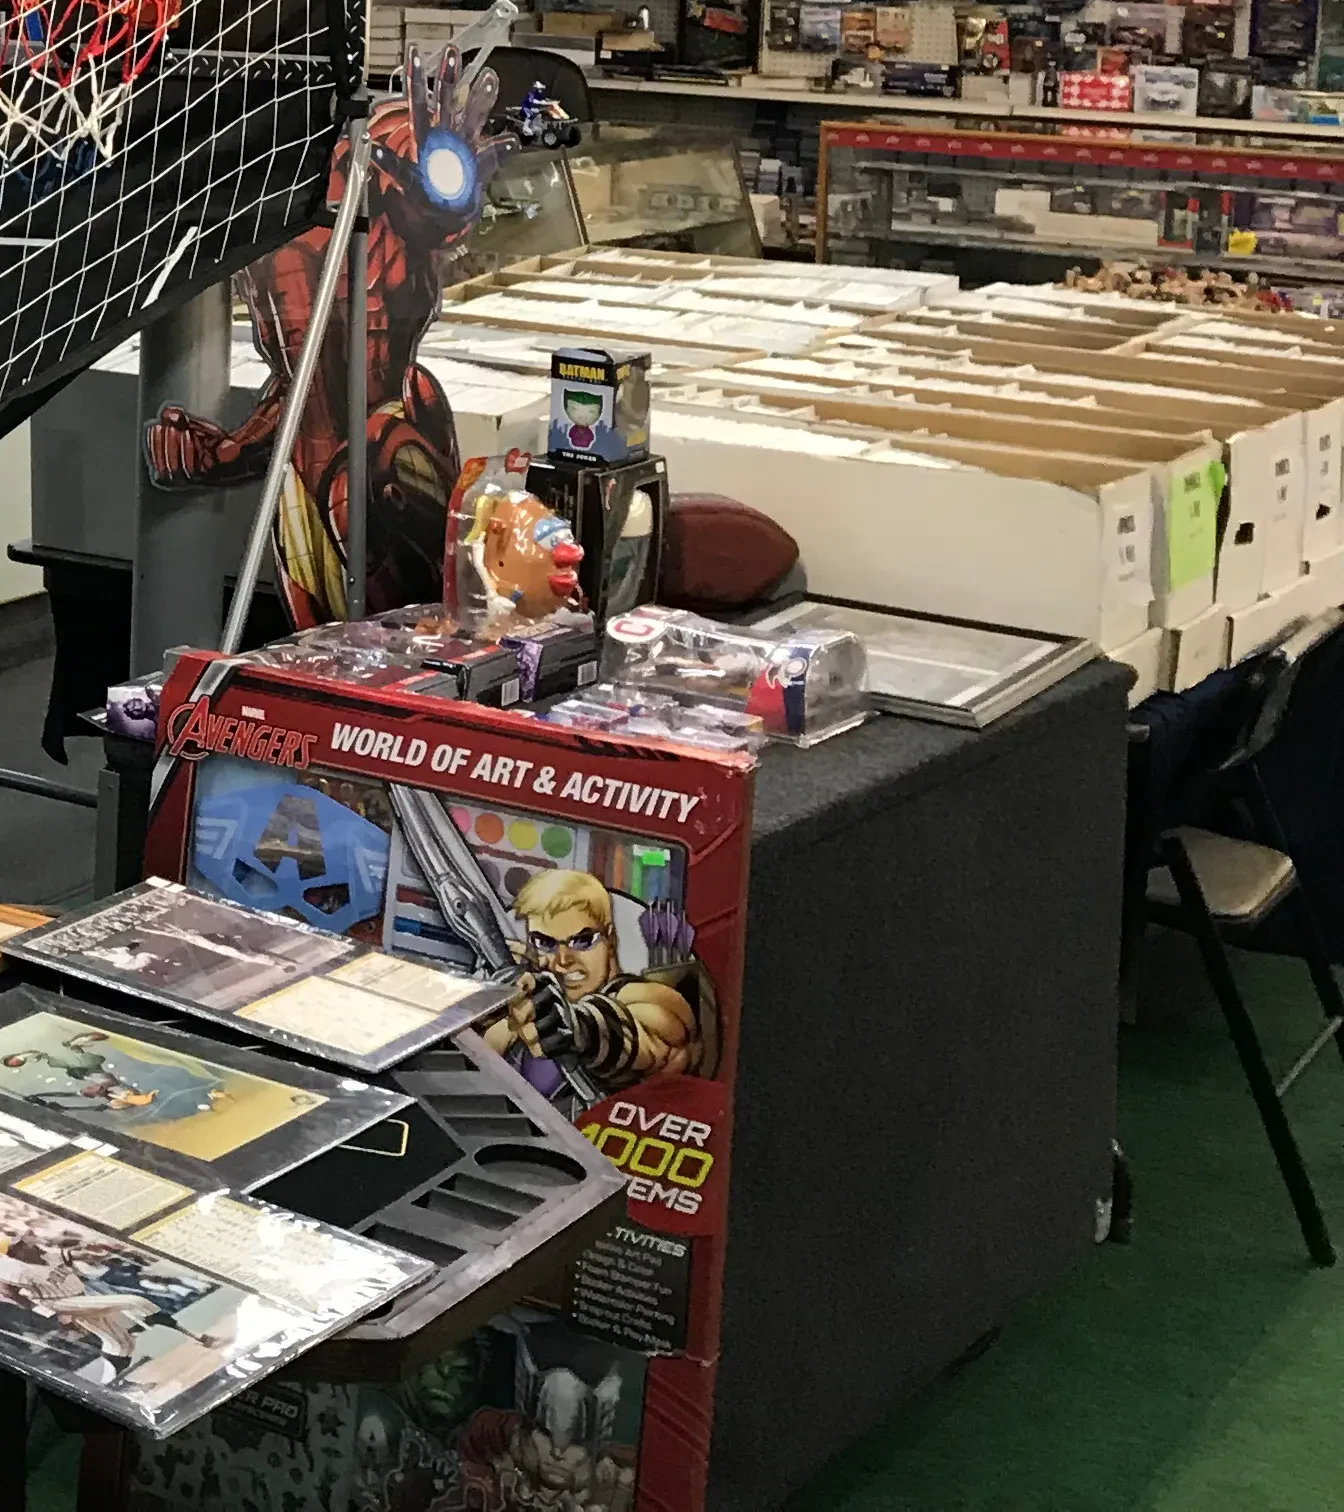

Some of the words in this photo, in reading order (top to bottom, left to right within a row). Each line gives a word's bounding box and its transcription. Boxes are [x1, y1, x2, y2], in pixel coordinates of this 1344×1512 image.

[559, 362, 605, 381] BATMAN
[168, 695, 318, 770] AVENGERS
[330, 723, 425, 768] WORLD
[431, 743, 467, 777] OF
[469, 750, 534, 791] ART
[532, 764, 556, 796] &
[560, 769, 700, 825] ACTIVITY
[608, 1101, 712, 1147] OVER
[624, 1173, 703, 1215] EMS
[615, 1226, 688, 1258] TIVITIES
